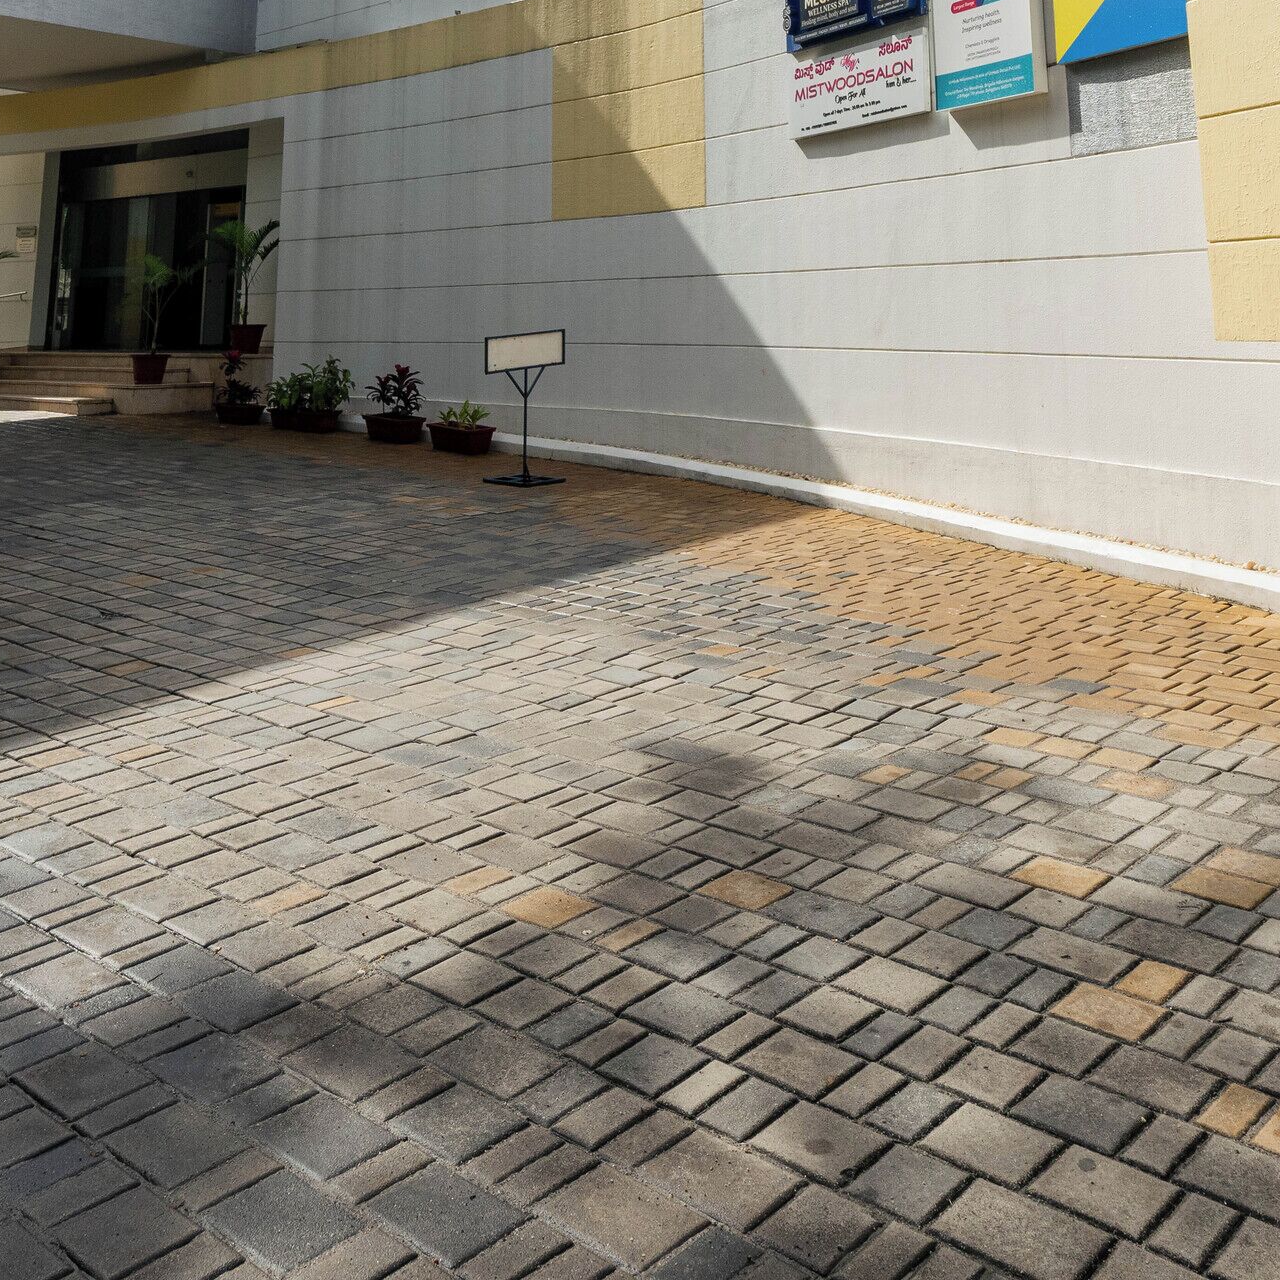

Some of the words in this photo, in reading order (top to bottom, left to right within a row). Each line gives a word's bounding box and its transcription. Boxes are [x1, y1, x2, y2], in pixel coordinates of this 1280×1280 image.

[808, 1, 837, 17] WELLNESS
[795, 59, 914, 102] MISTWOODSALON
[835, 94, 847, 104] Open
